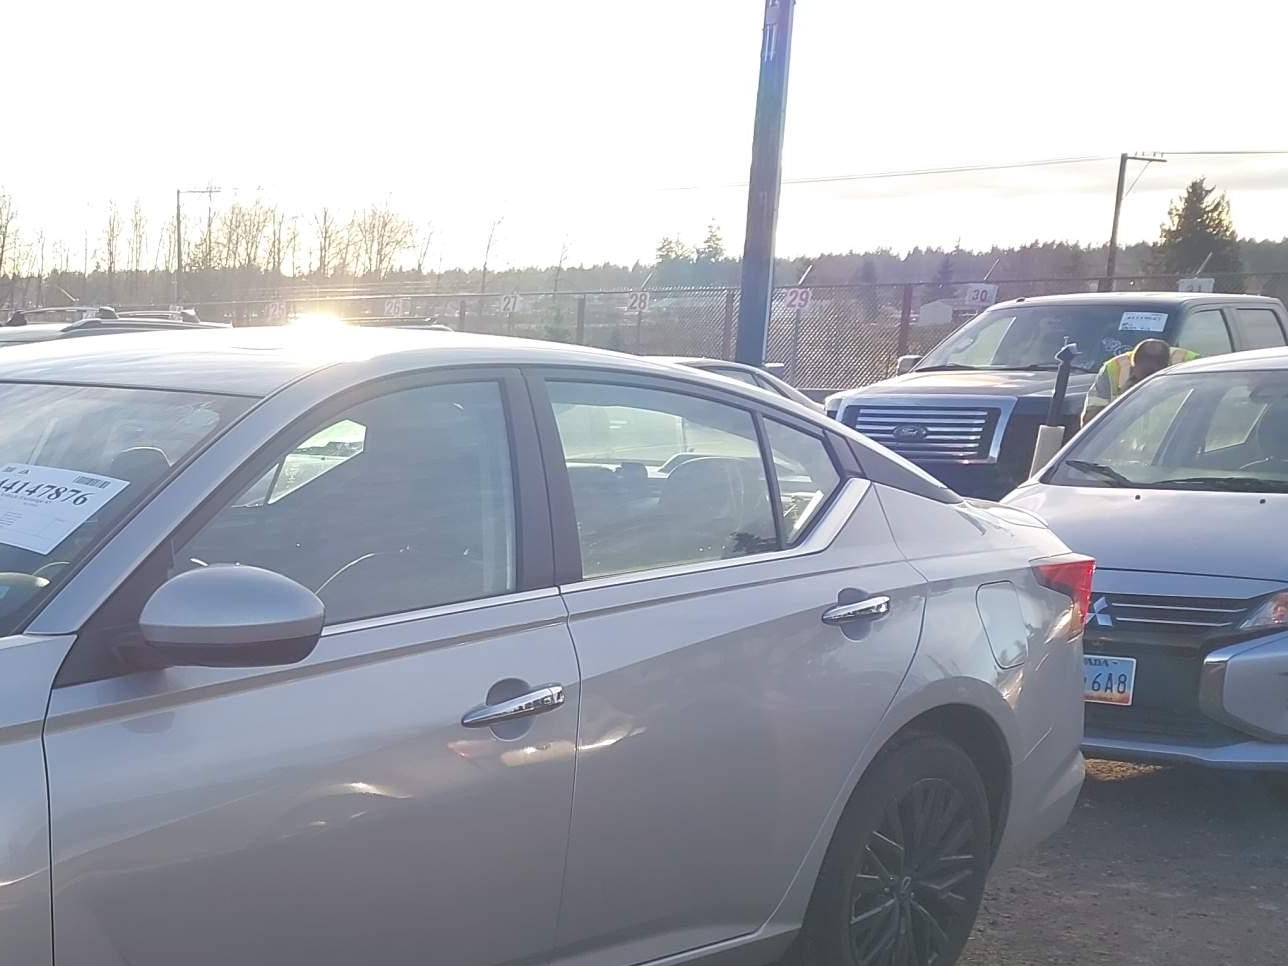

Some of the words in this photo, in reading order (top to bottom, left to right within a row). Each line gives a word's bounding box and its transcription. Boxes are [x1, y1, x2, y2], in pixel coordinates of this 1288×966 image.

[502, 295, 518, 312] 27
[627, 293, 648, 310] 28
[786, 289, 810, 308] 29
